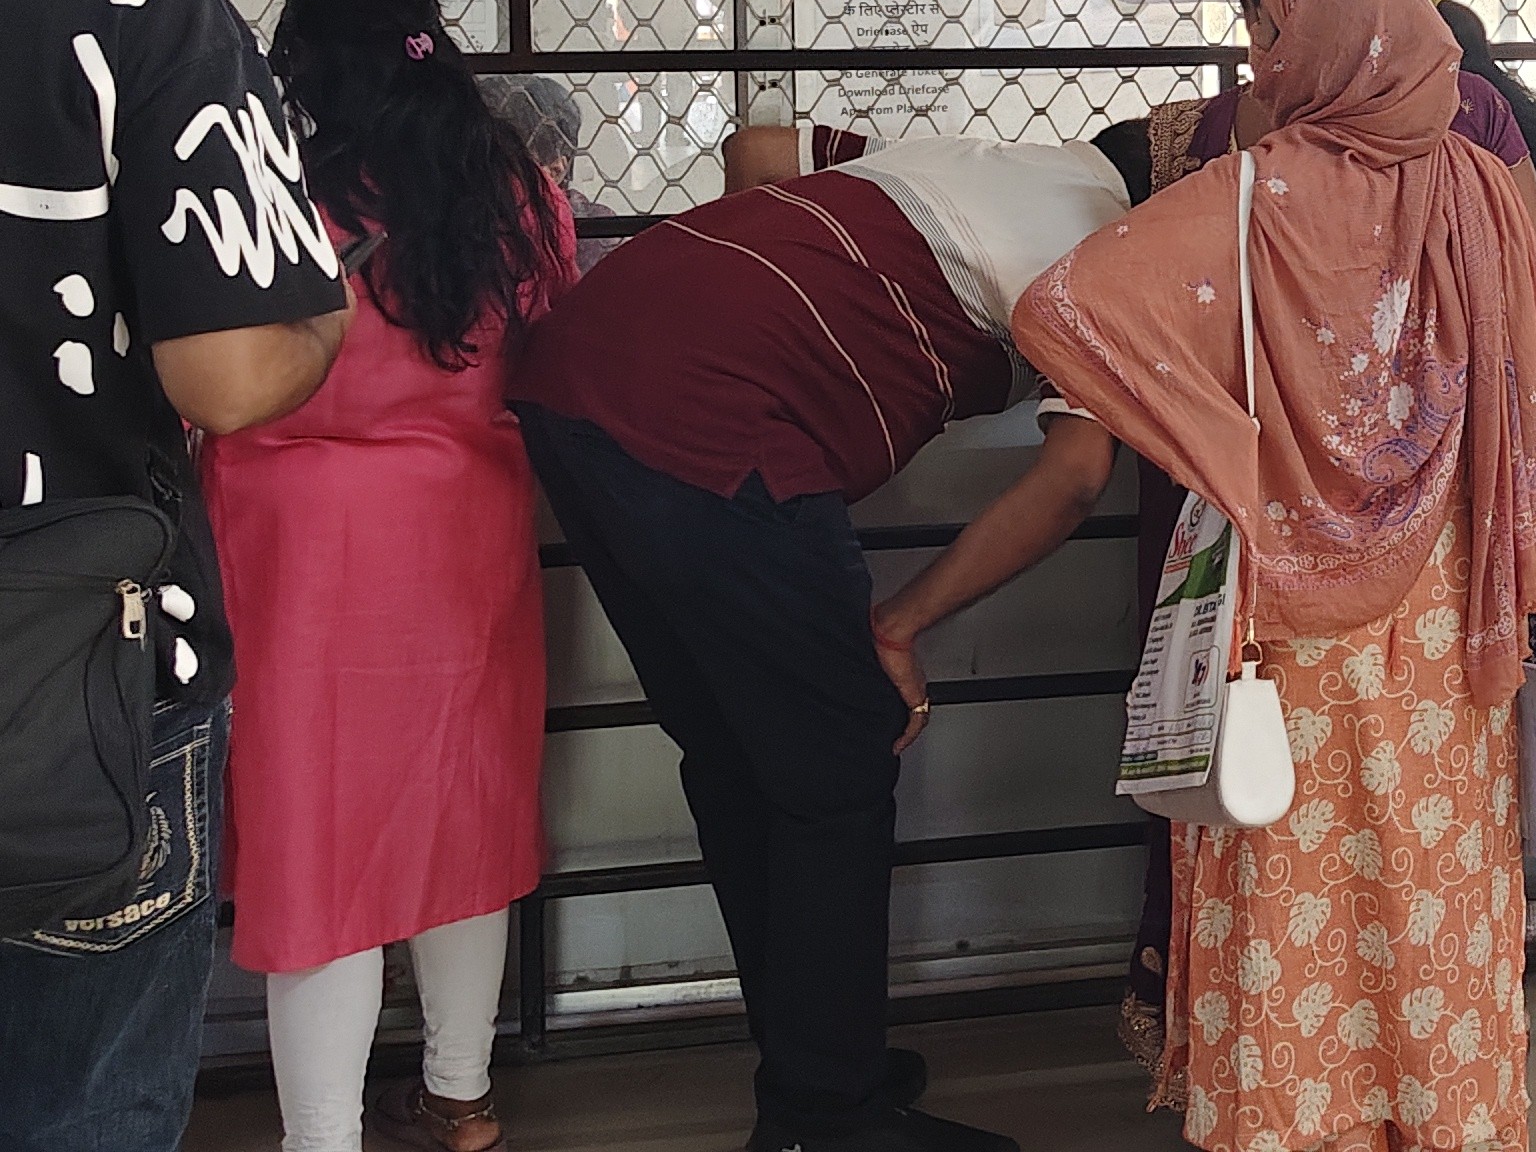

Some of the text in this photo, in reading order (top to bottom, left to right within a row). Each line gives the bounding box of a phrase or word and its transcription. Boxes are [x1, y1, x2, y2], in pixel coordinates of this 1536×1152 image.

[859, 1, 883, 17] लिए
[838, 83, 950, 98] Download Driefcase
